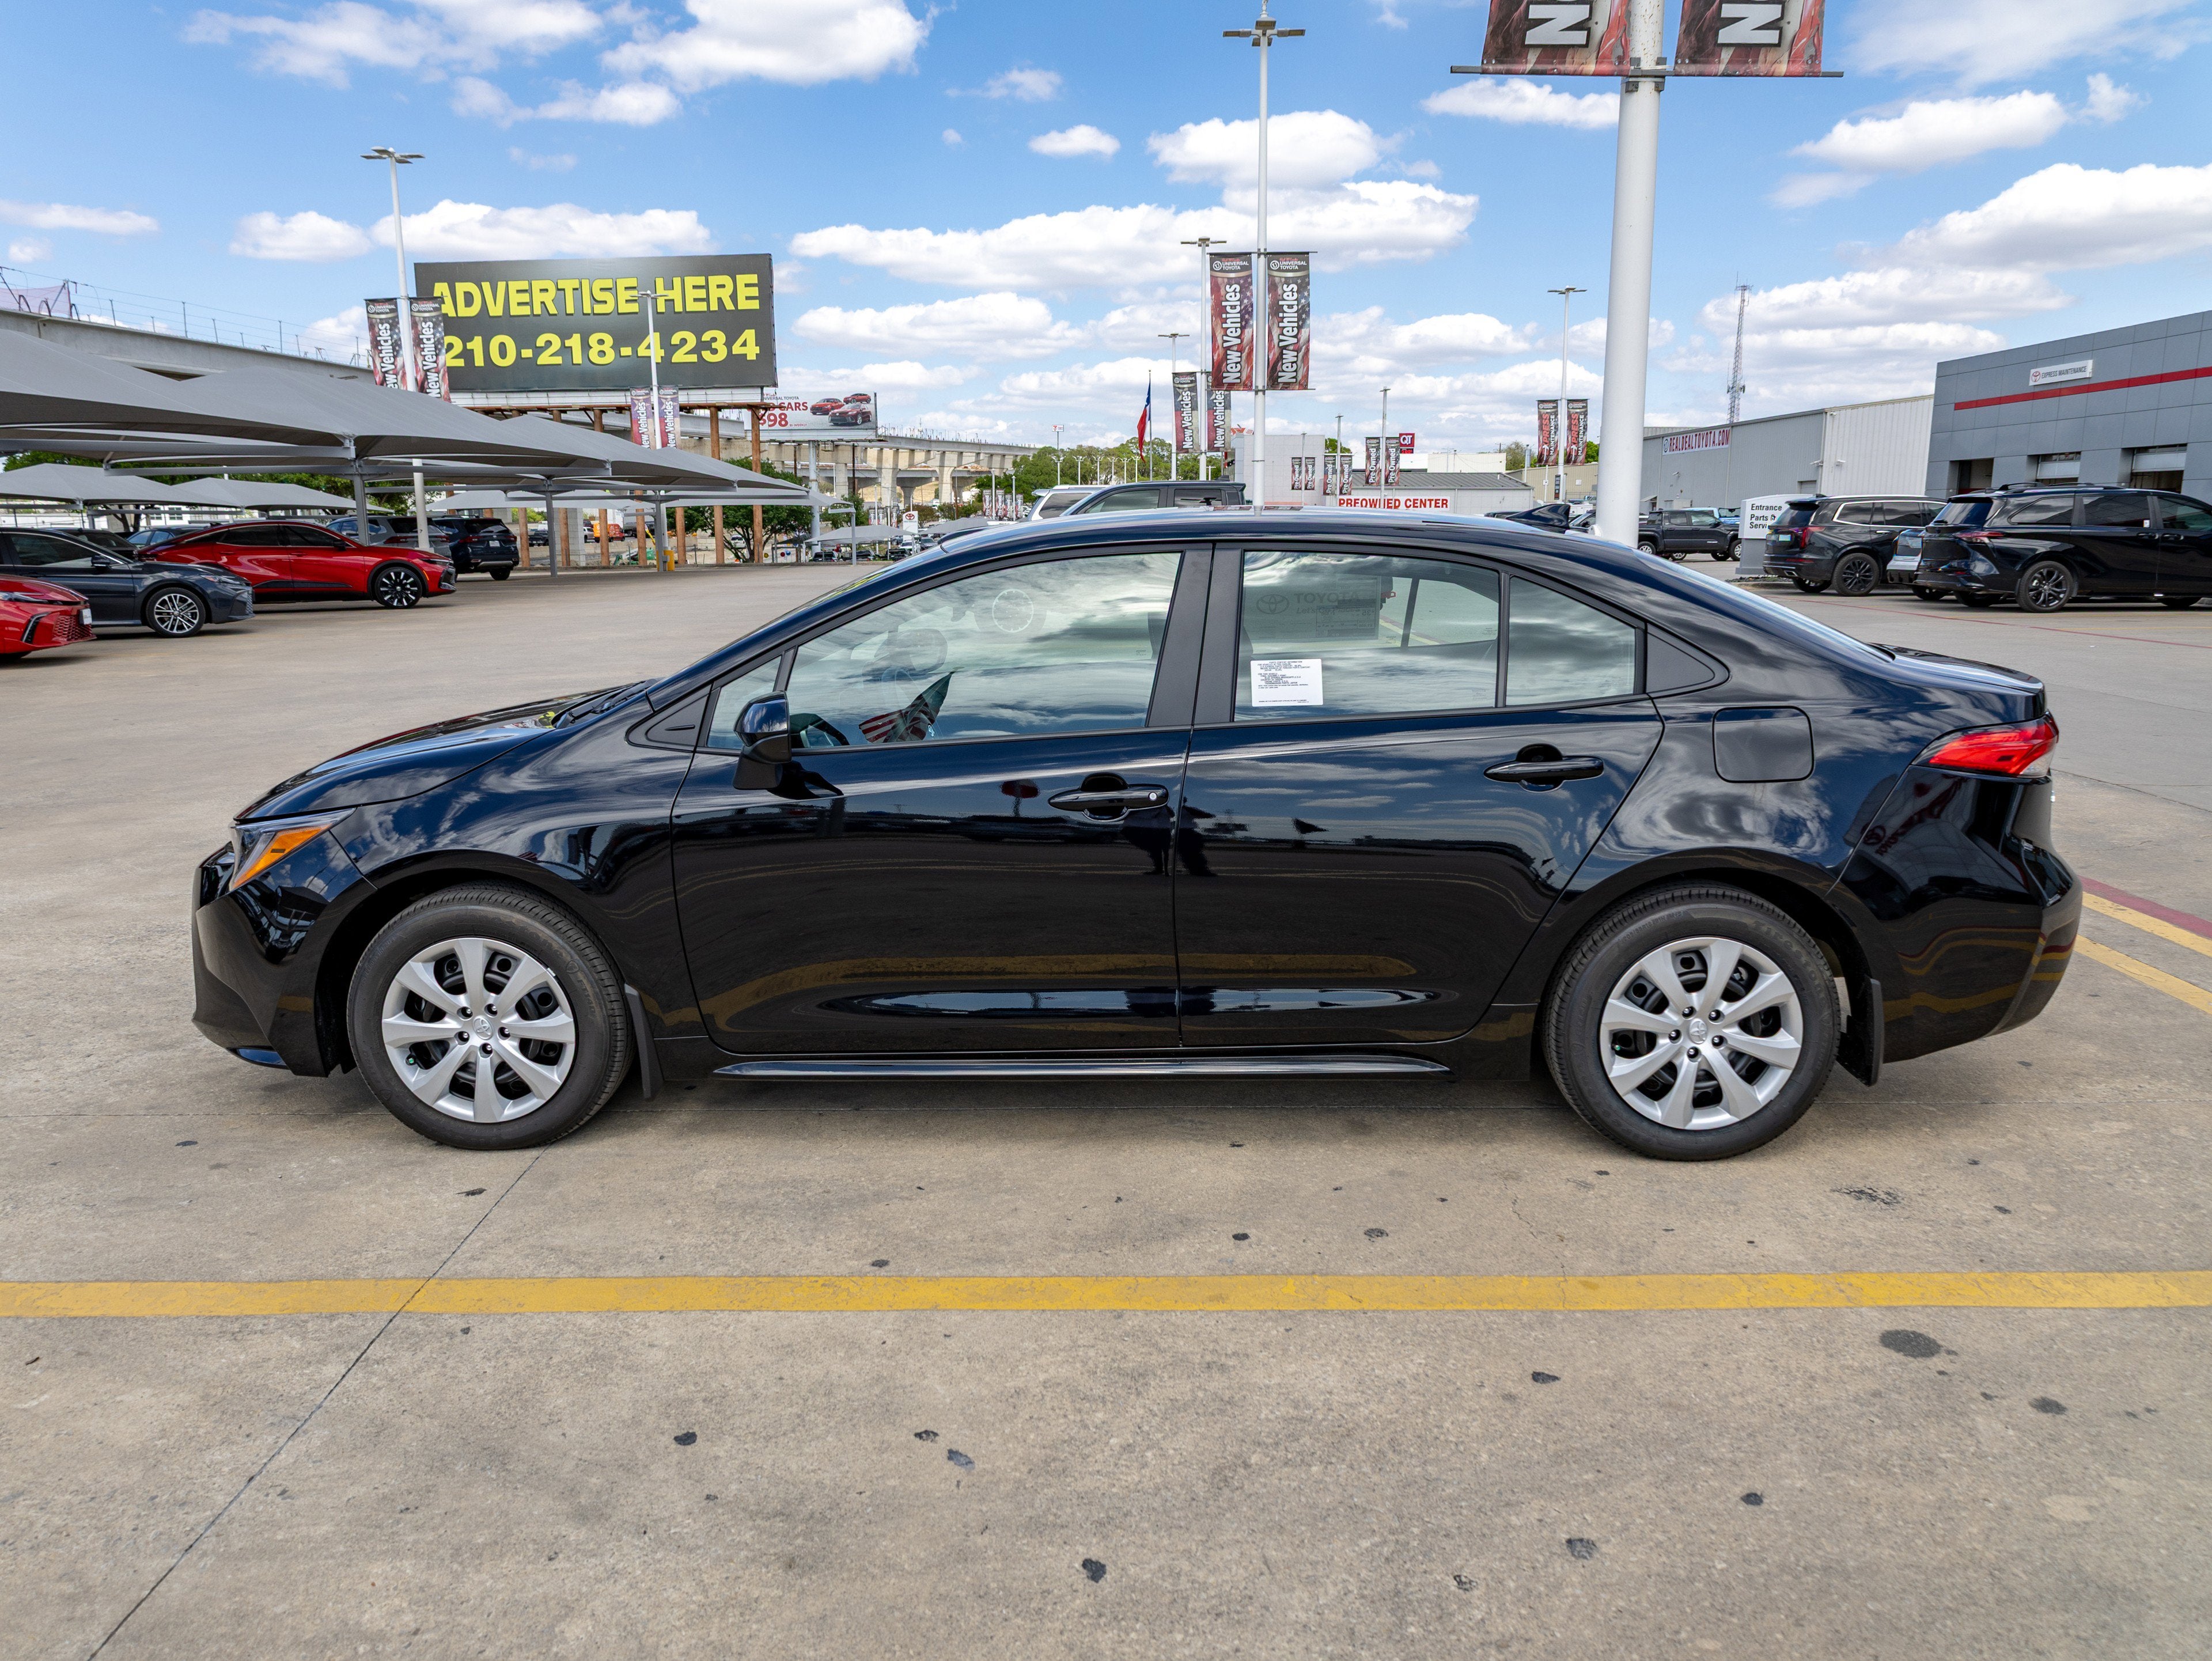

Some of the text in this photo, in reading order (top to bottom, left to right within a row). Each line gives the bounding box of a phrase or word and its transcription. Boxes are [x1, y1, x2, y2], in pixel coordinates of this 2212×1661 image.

[433, 274, 760, 317] ADVERTISE HERE
[1222, 283, 1241, 347] Vehicles
[1278, 283, 1298, 347] Vehicles
[377, 323, 396, 372] Vehicles
[419, 321, 438, 370] Vehicles
[445, 329, 760, 367] 210-218-4234
[385, 374, 399, 389] ew
[1222, 350, 1241, 384] New
[1278, 349, 1297, 383] New
[2041, 366, 2087, 379] EXPRESS MAINTENANCE
[426, 373, 442, 398] New
[637, 402, 648, 433] Vehicles
[664, 401, 675, 432] Vehicles
[779, 402, 808, 411] CARS
[1181, 391, 1193, 448] New Vehicles
[1213, 390, 1225, 448] New Vehicles
[1400, 435, 1412, 444] QT
[1669, 429, 1730, 452] REALDEALTOYOTA.COM
[1404, 498, 1448, 509] CENTER
